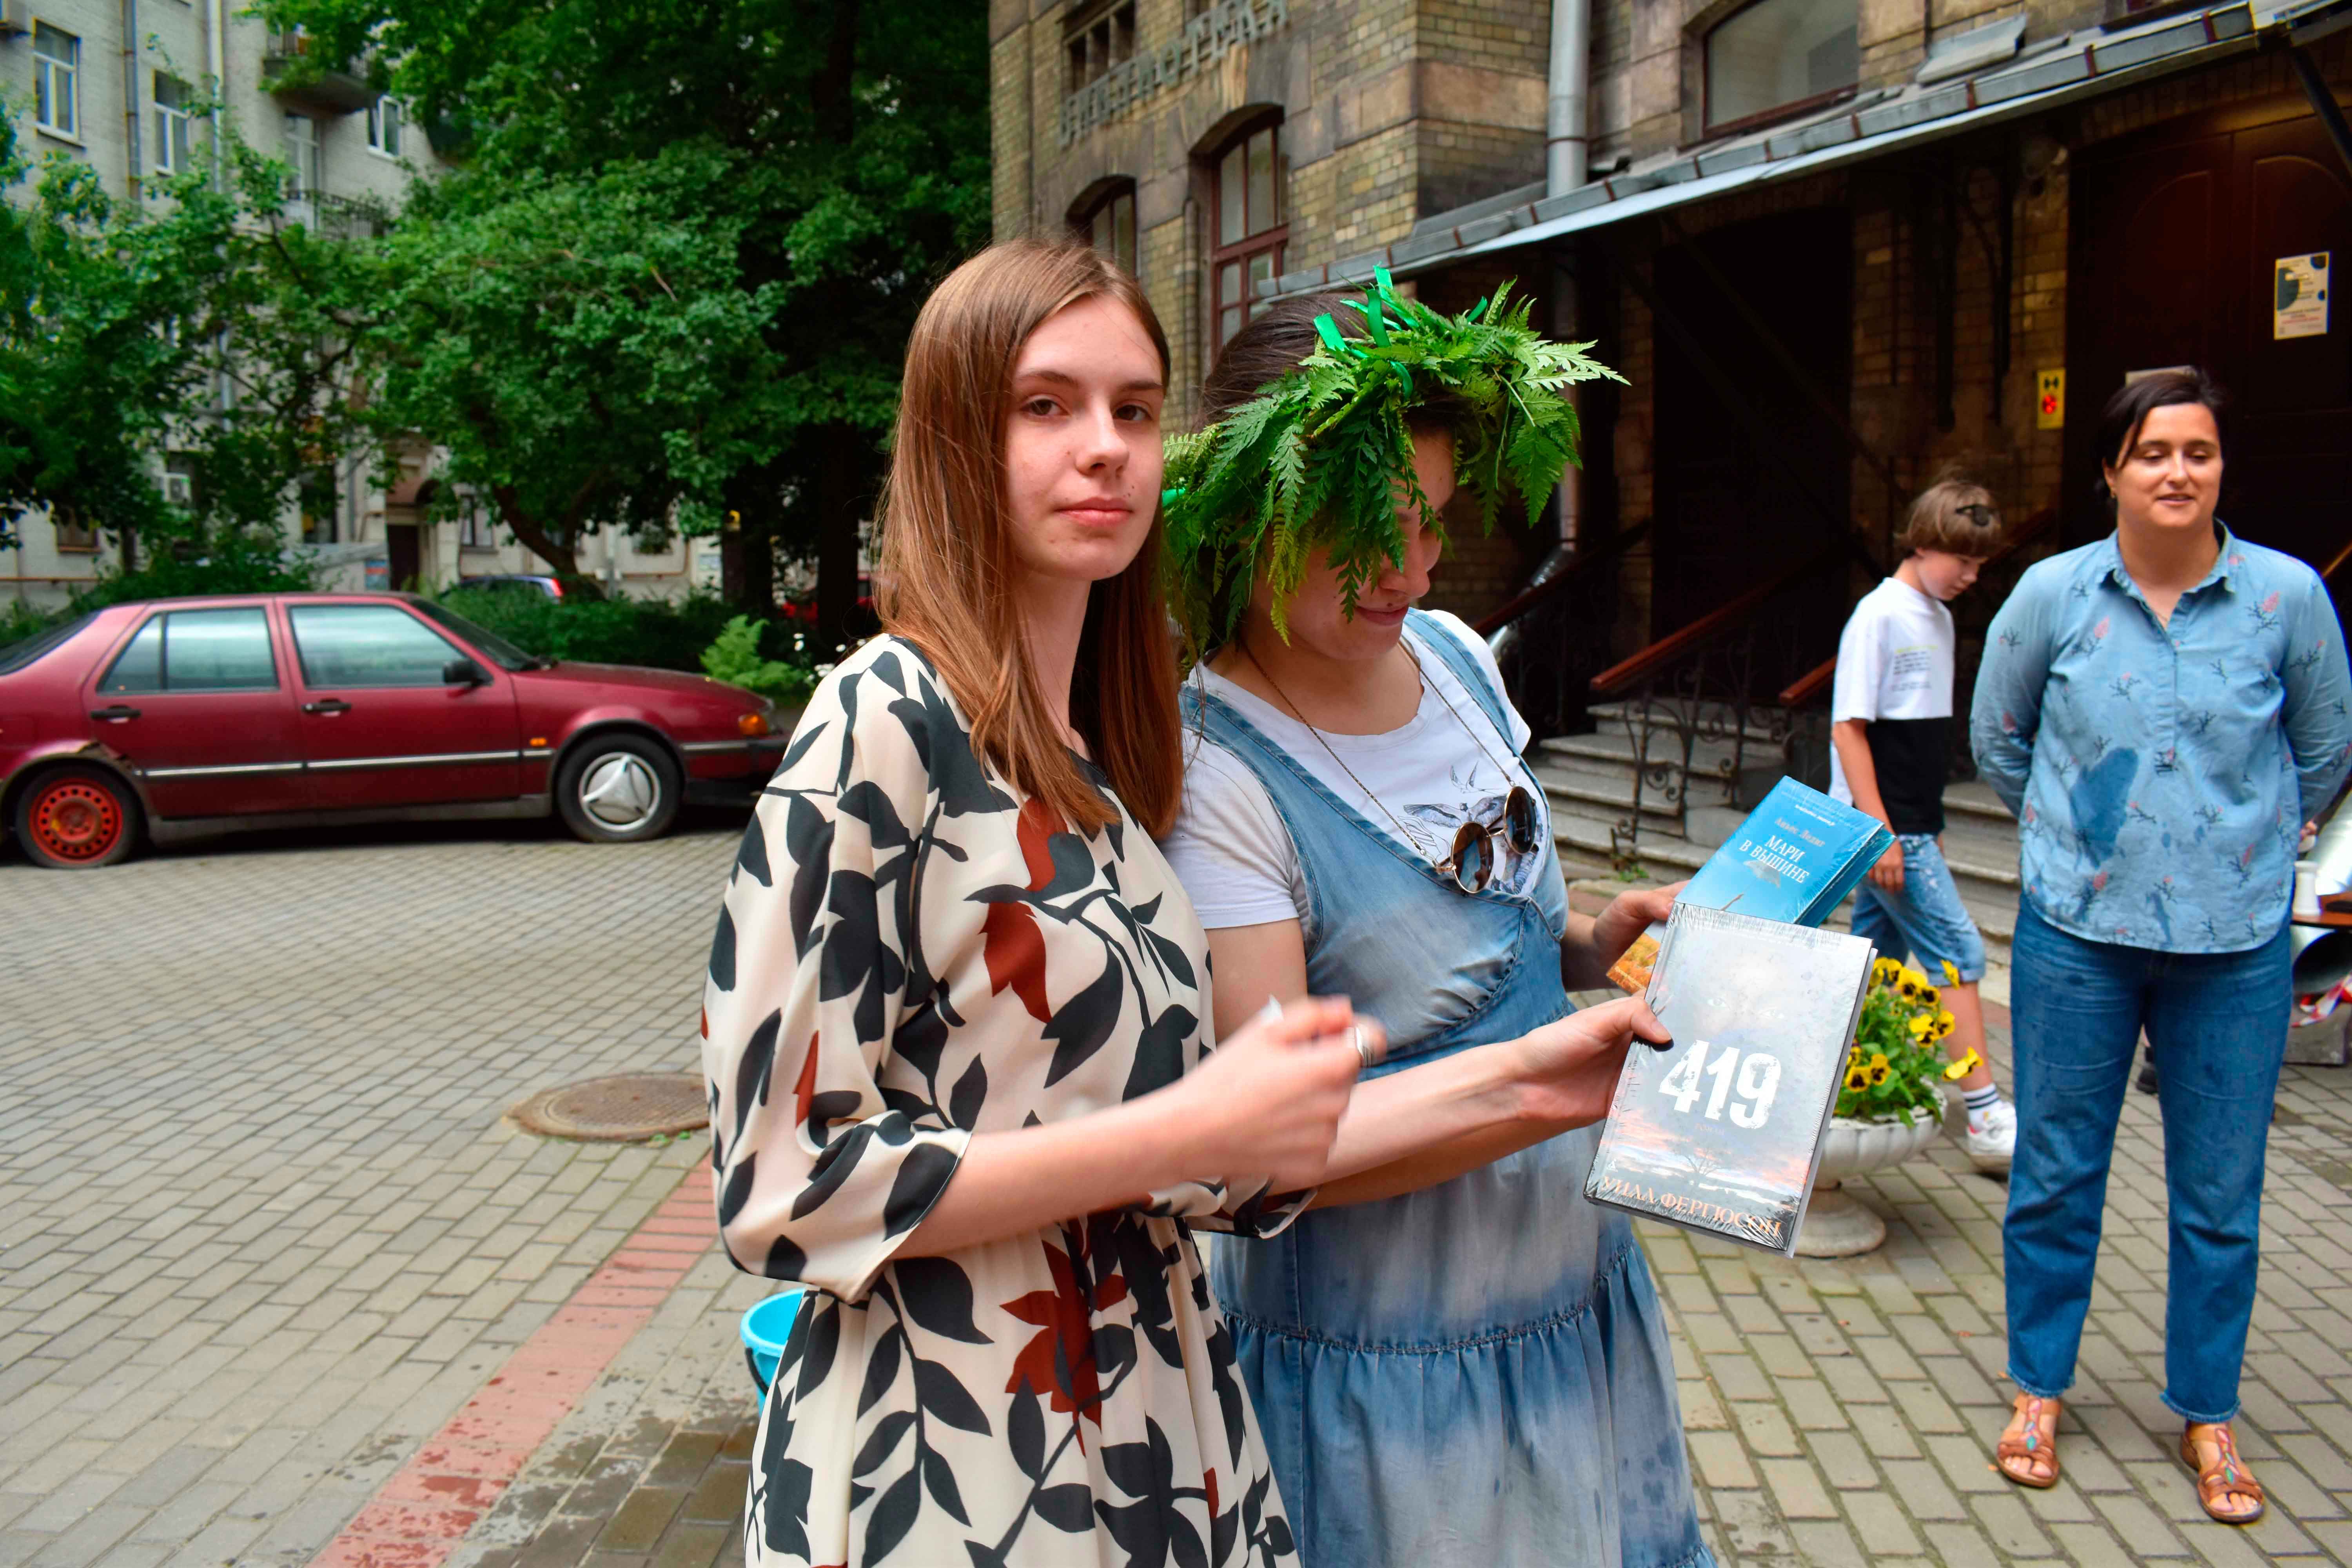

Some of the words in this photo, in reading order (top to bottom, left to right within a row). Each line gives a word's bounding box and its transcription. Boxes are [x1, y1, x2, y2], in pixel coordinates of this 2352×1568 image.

[1739, 839, 1752, 851] В
[1750, 845, 1810, 884] ВЫШИНЕ
[1765, 835, 1806, 862] МАРИ
[1658, 1039, 1781, 1129] 419
